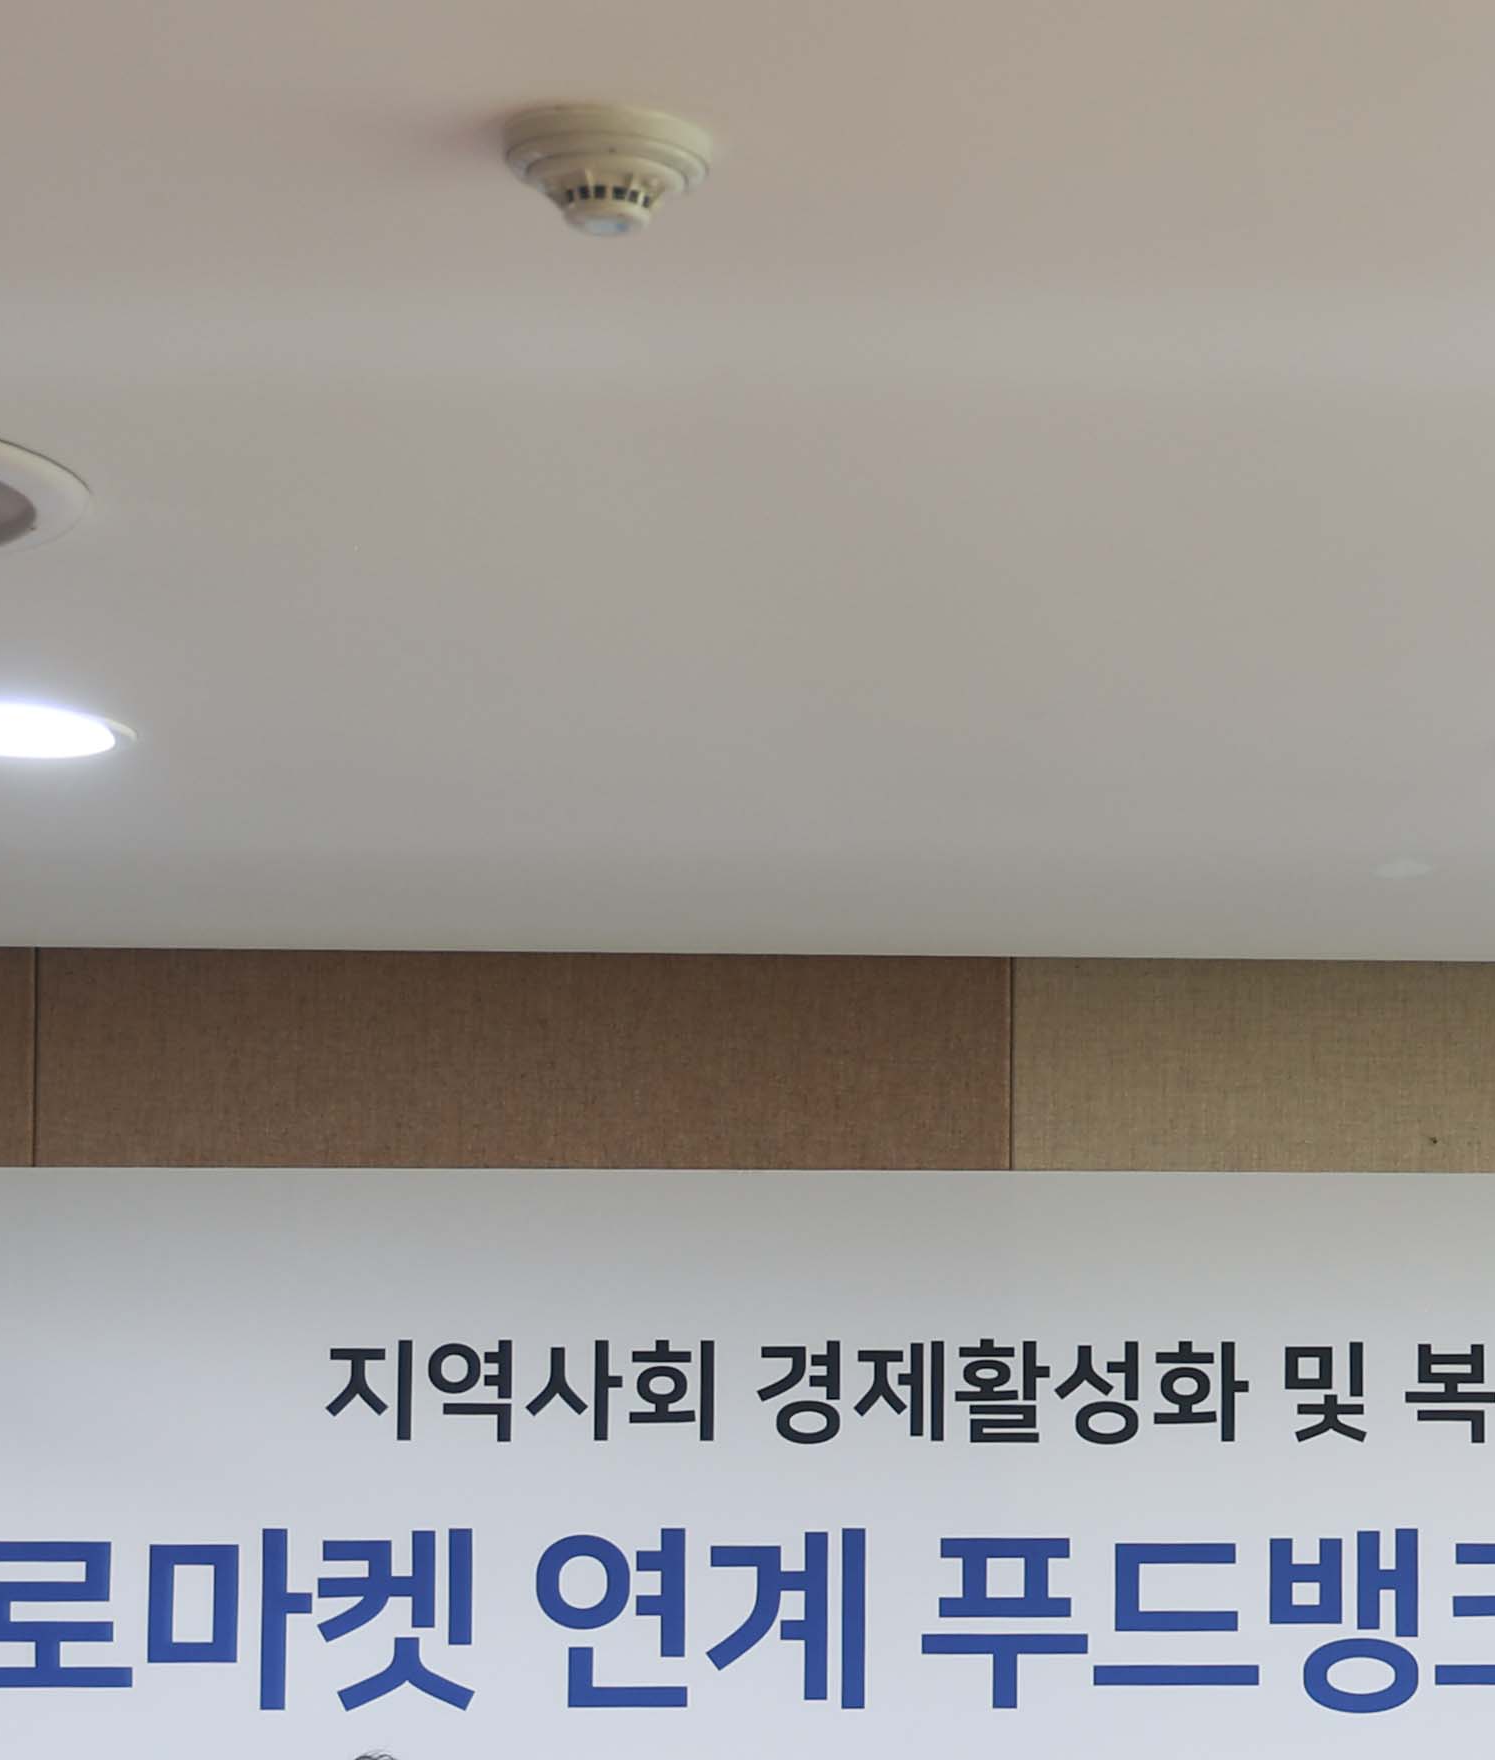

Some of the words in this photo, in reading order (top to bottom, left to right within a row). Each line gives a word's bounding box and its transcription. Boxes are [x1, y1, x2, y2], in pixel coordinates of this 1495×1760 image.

[325, 1339, 715, 1442] 지역사회
[756, 1338, 1249, 1445] 경제활성화
[1285, 1341, 1367, 1442] 및
[536, 1528, 866, 1709] 연계
